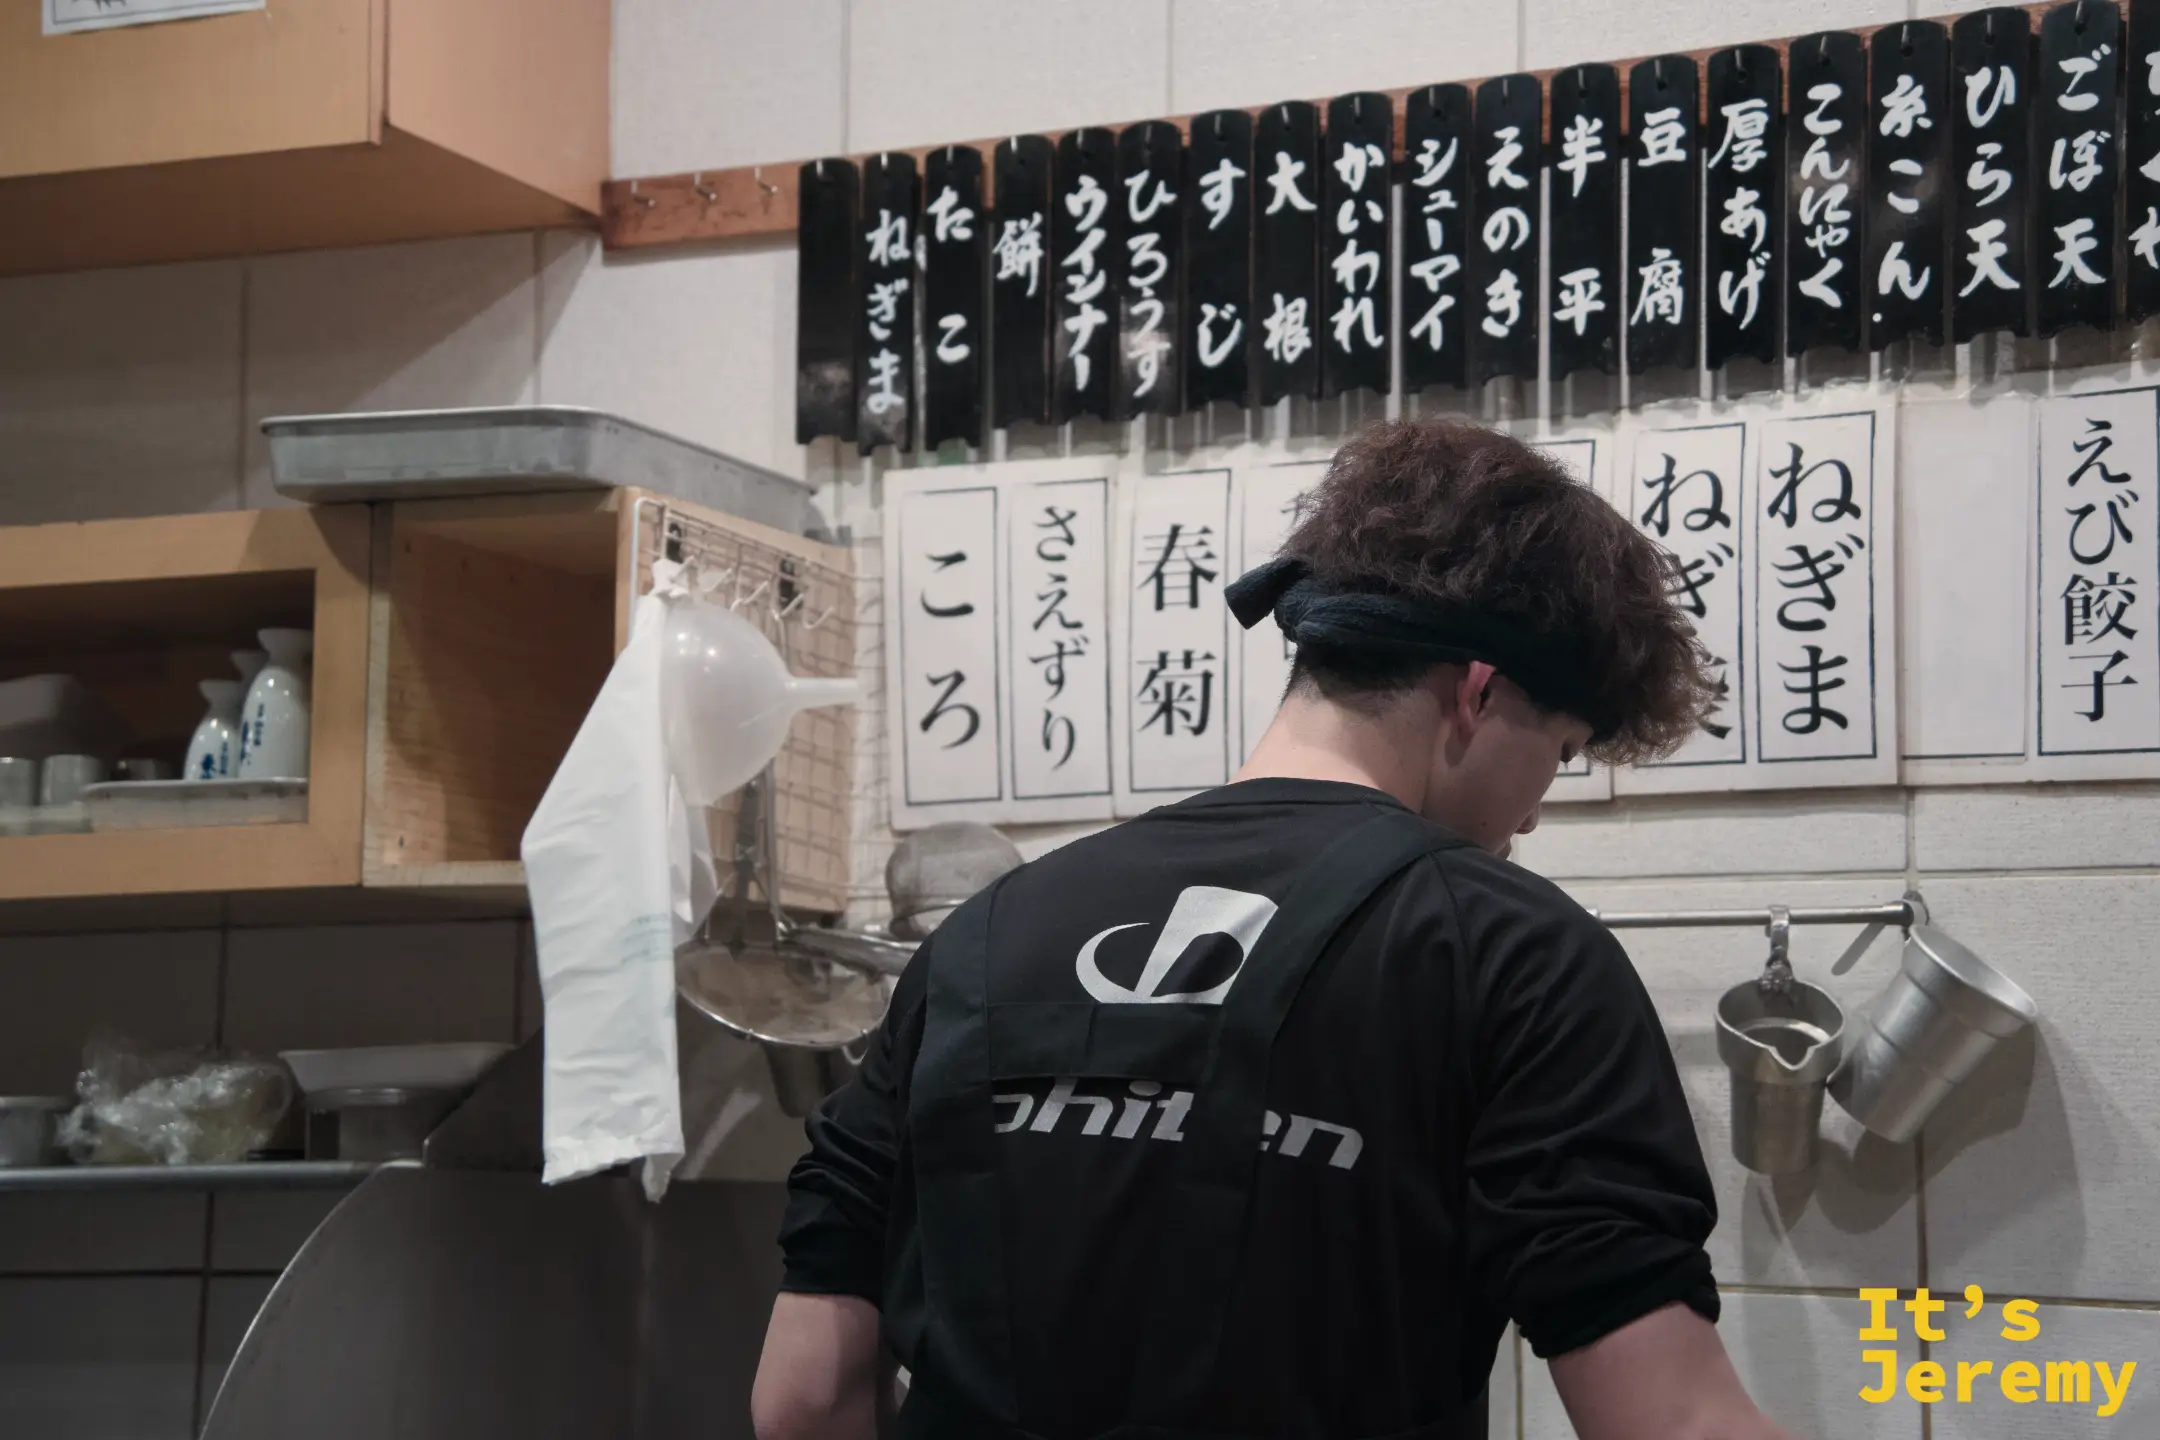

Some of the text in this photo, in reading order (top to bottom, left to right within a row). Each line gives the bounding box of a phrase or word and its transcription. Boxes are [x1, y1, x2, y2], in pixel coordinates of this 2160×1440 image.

[928, 187, 974, 363] たこ
[1198, 158, 1246, 367] すじ
[1263, 151, 1317, 363] 大根
[1331, 142, 1385, 353] かいわれ
[1410, 137, 1460, 351] シューマイ
[1481, 126, 1530, 338] えのき
[1553, 114, 1606, 336] 半平
[1630, 107, 1687, 326] 豆腐
[1708, 98, 1771, 330] 厚あげ
[1799, 83, 1851, 308] こんにゃく
[1879, 74, 1932, 300] 糸こん
[1958, 65, 2020, 297] ひら天
[2048, 43, 2111, 289] ごぼ天
[867, 210, 908, 414] ねぎま
[1062, 175, 1107, 391] ウインナー
[1124, 169, 1177, 397] ひろうす
[919, 551, 980, 750] ころ
[1028, 505, 1090, 771] さえずり
[1137, 523, 1218, 737] 春菊
[1767, 441, 1865, 735] ねぎま
[2059, 418, 2140, 723] えび餃子
